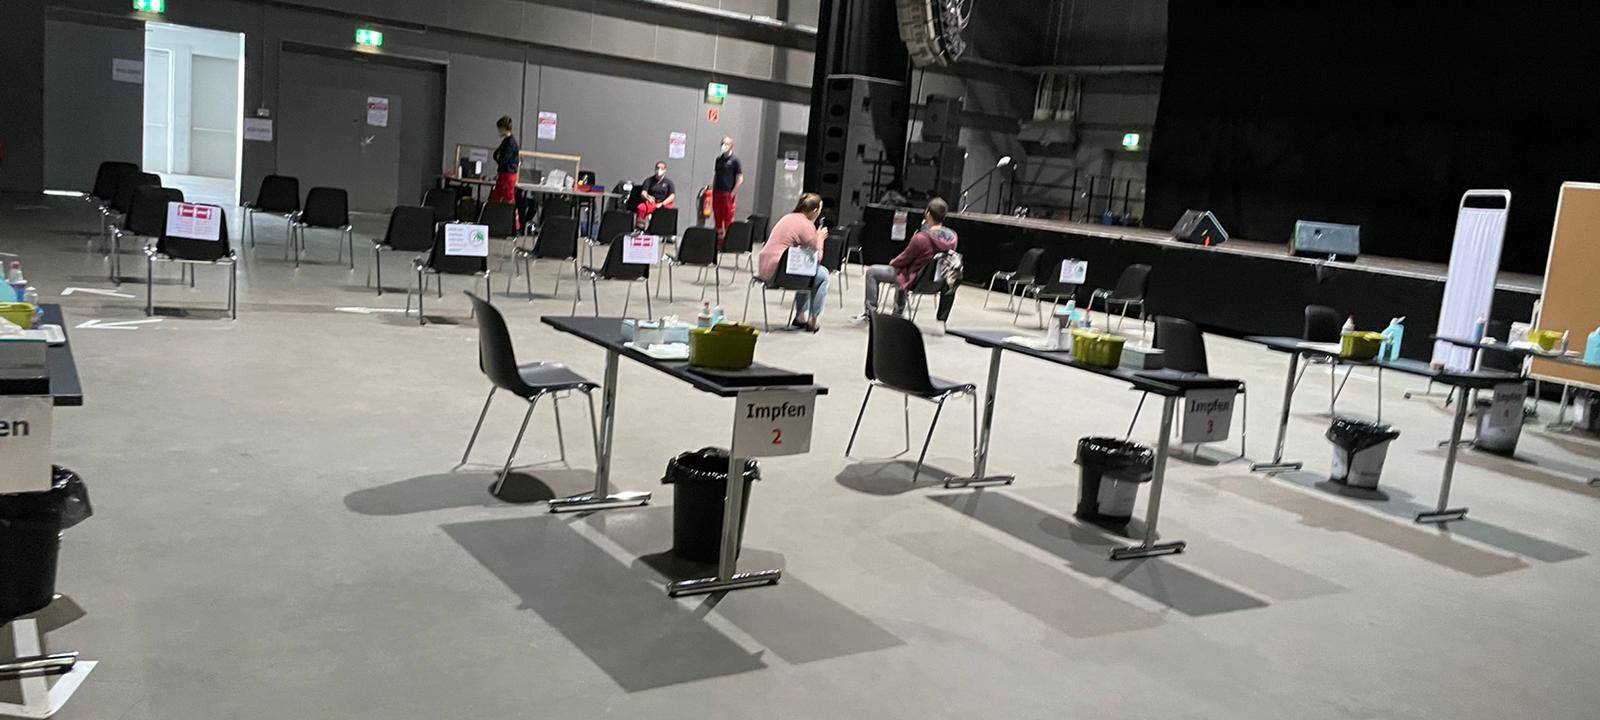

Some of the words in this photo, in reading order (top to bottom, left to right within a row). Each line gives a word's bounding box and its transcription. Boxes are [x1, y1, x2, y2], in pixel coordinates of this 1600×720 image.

[747, 401, 805, 421] Impfen
[1191, 399, 1229, 414] Impfen
[1207, 420, 1214, 433] 3
[772, 428, 782, 444] 2
